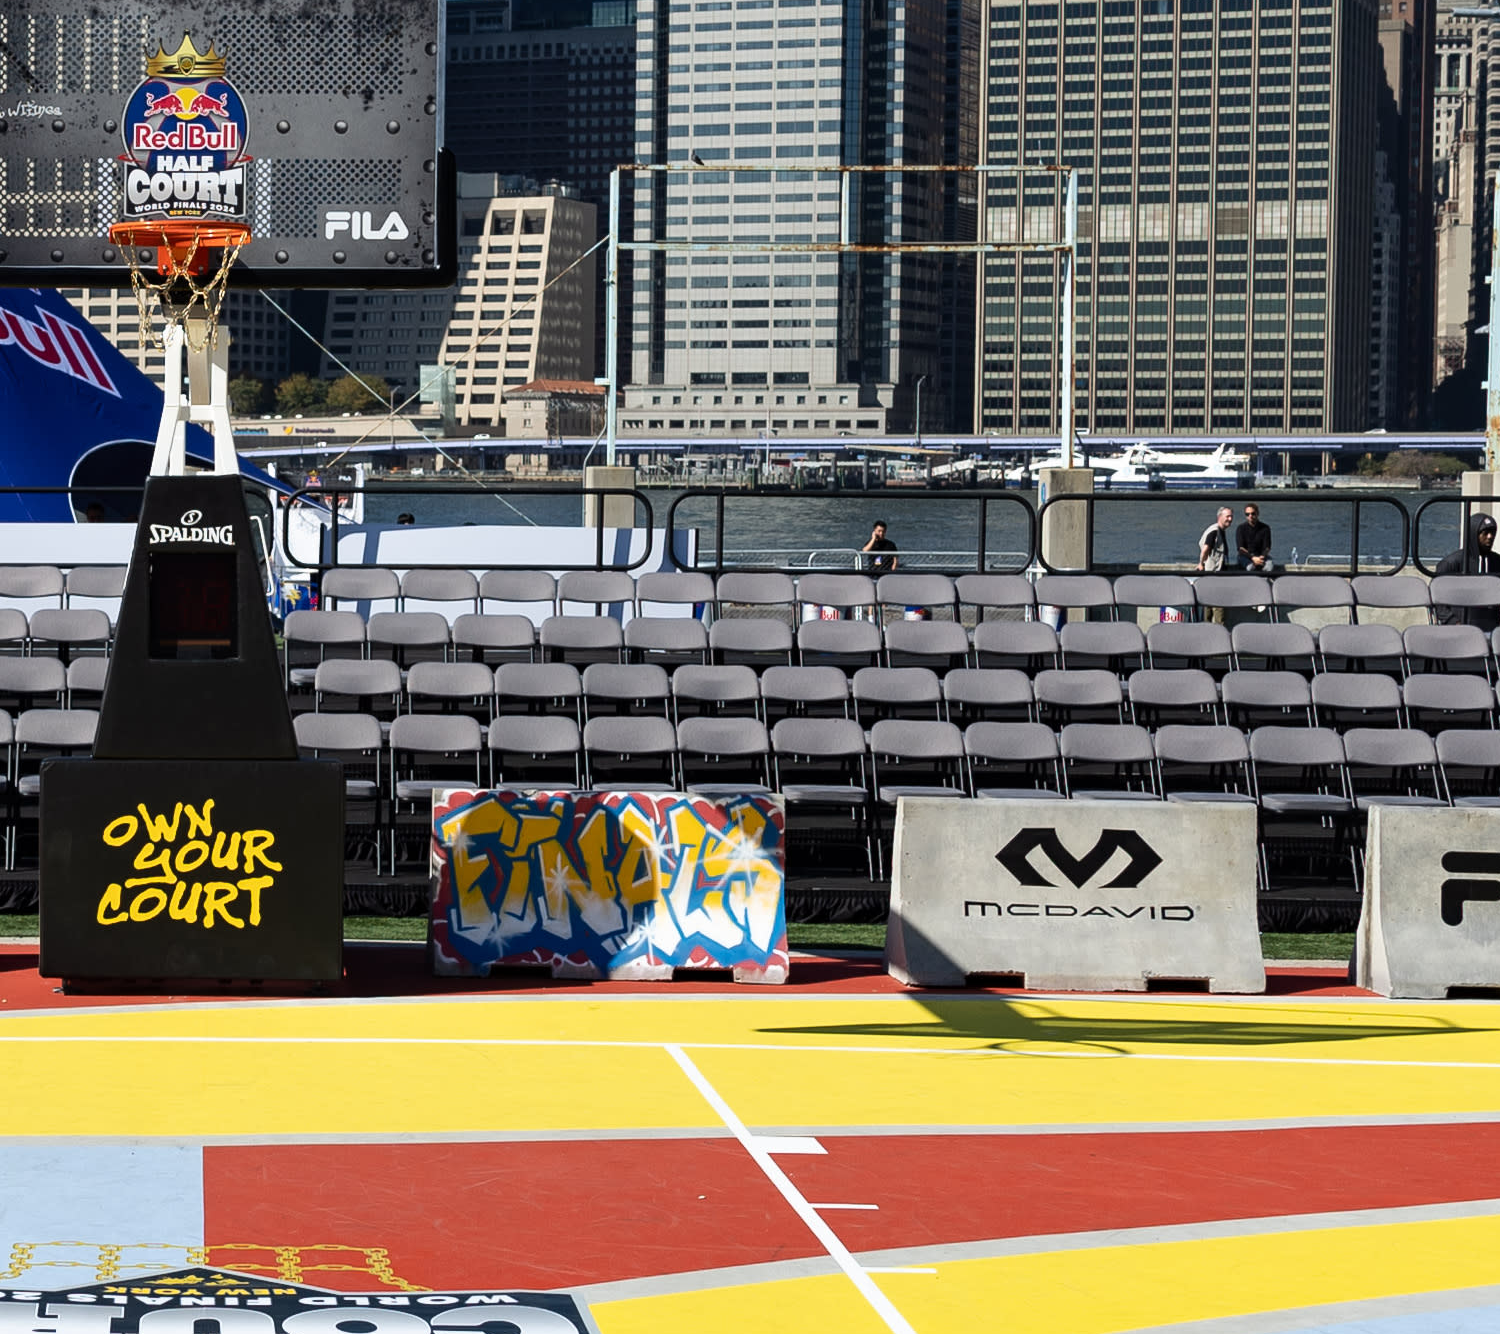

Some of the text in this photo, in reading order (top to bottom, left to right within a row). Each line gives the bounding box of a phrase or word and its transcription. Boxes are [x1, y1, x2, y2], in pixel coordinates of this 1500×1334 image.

[134, 122, 237, 150] Red Bull
[157, 155, 213, 171] HALF
[128, 168, 243, 205] COURT
[134, 203, 171, 213] WORLD
[209, 204, 235, 213] 2024
[325, 211, 409, 241] FILA
[149, 524, 233, 545] SPALDING
[103, 798, 215, 846] OWN
[124, 829, 283, 888] YOUR
[441, 798, 784, 955] FINALS
[97, 875, 274, 929] COURT
[67, 1293, 272, 1306] FINALS
[103, 1286, 297, 1295] NEW YORK
[298, 1294, 518, 1306] WORLD
